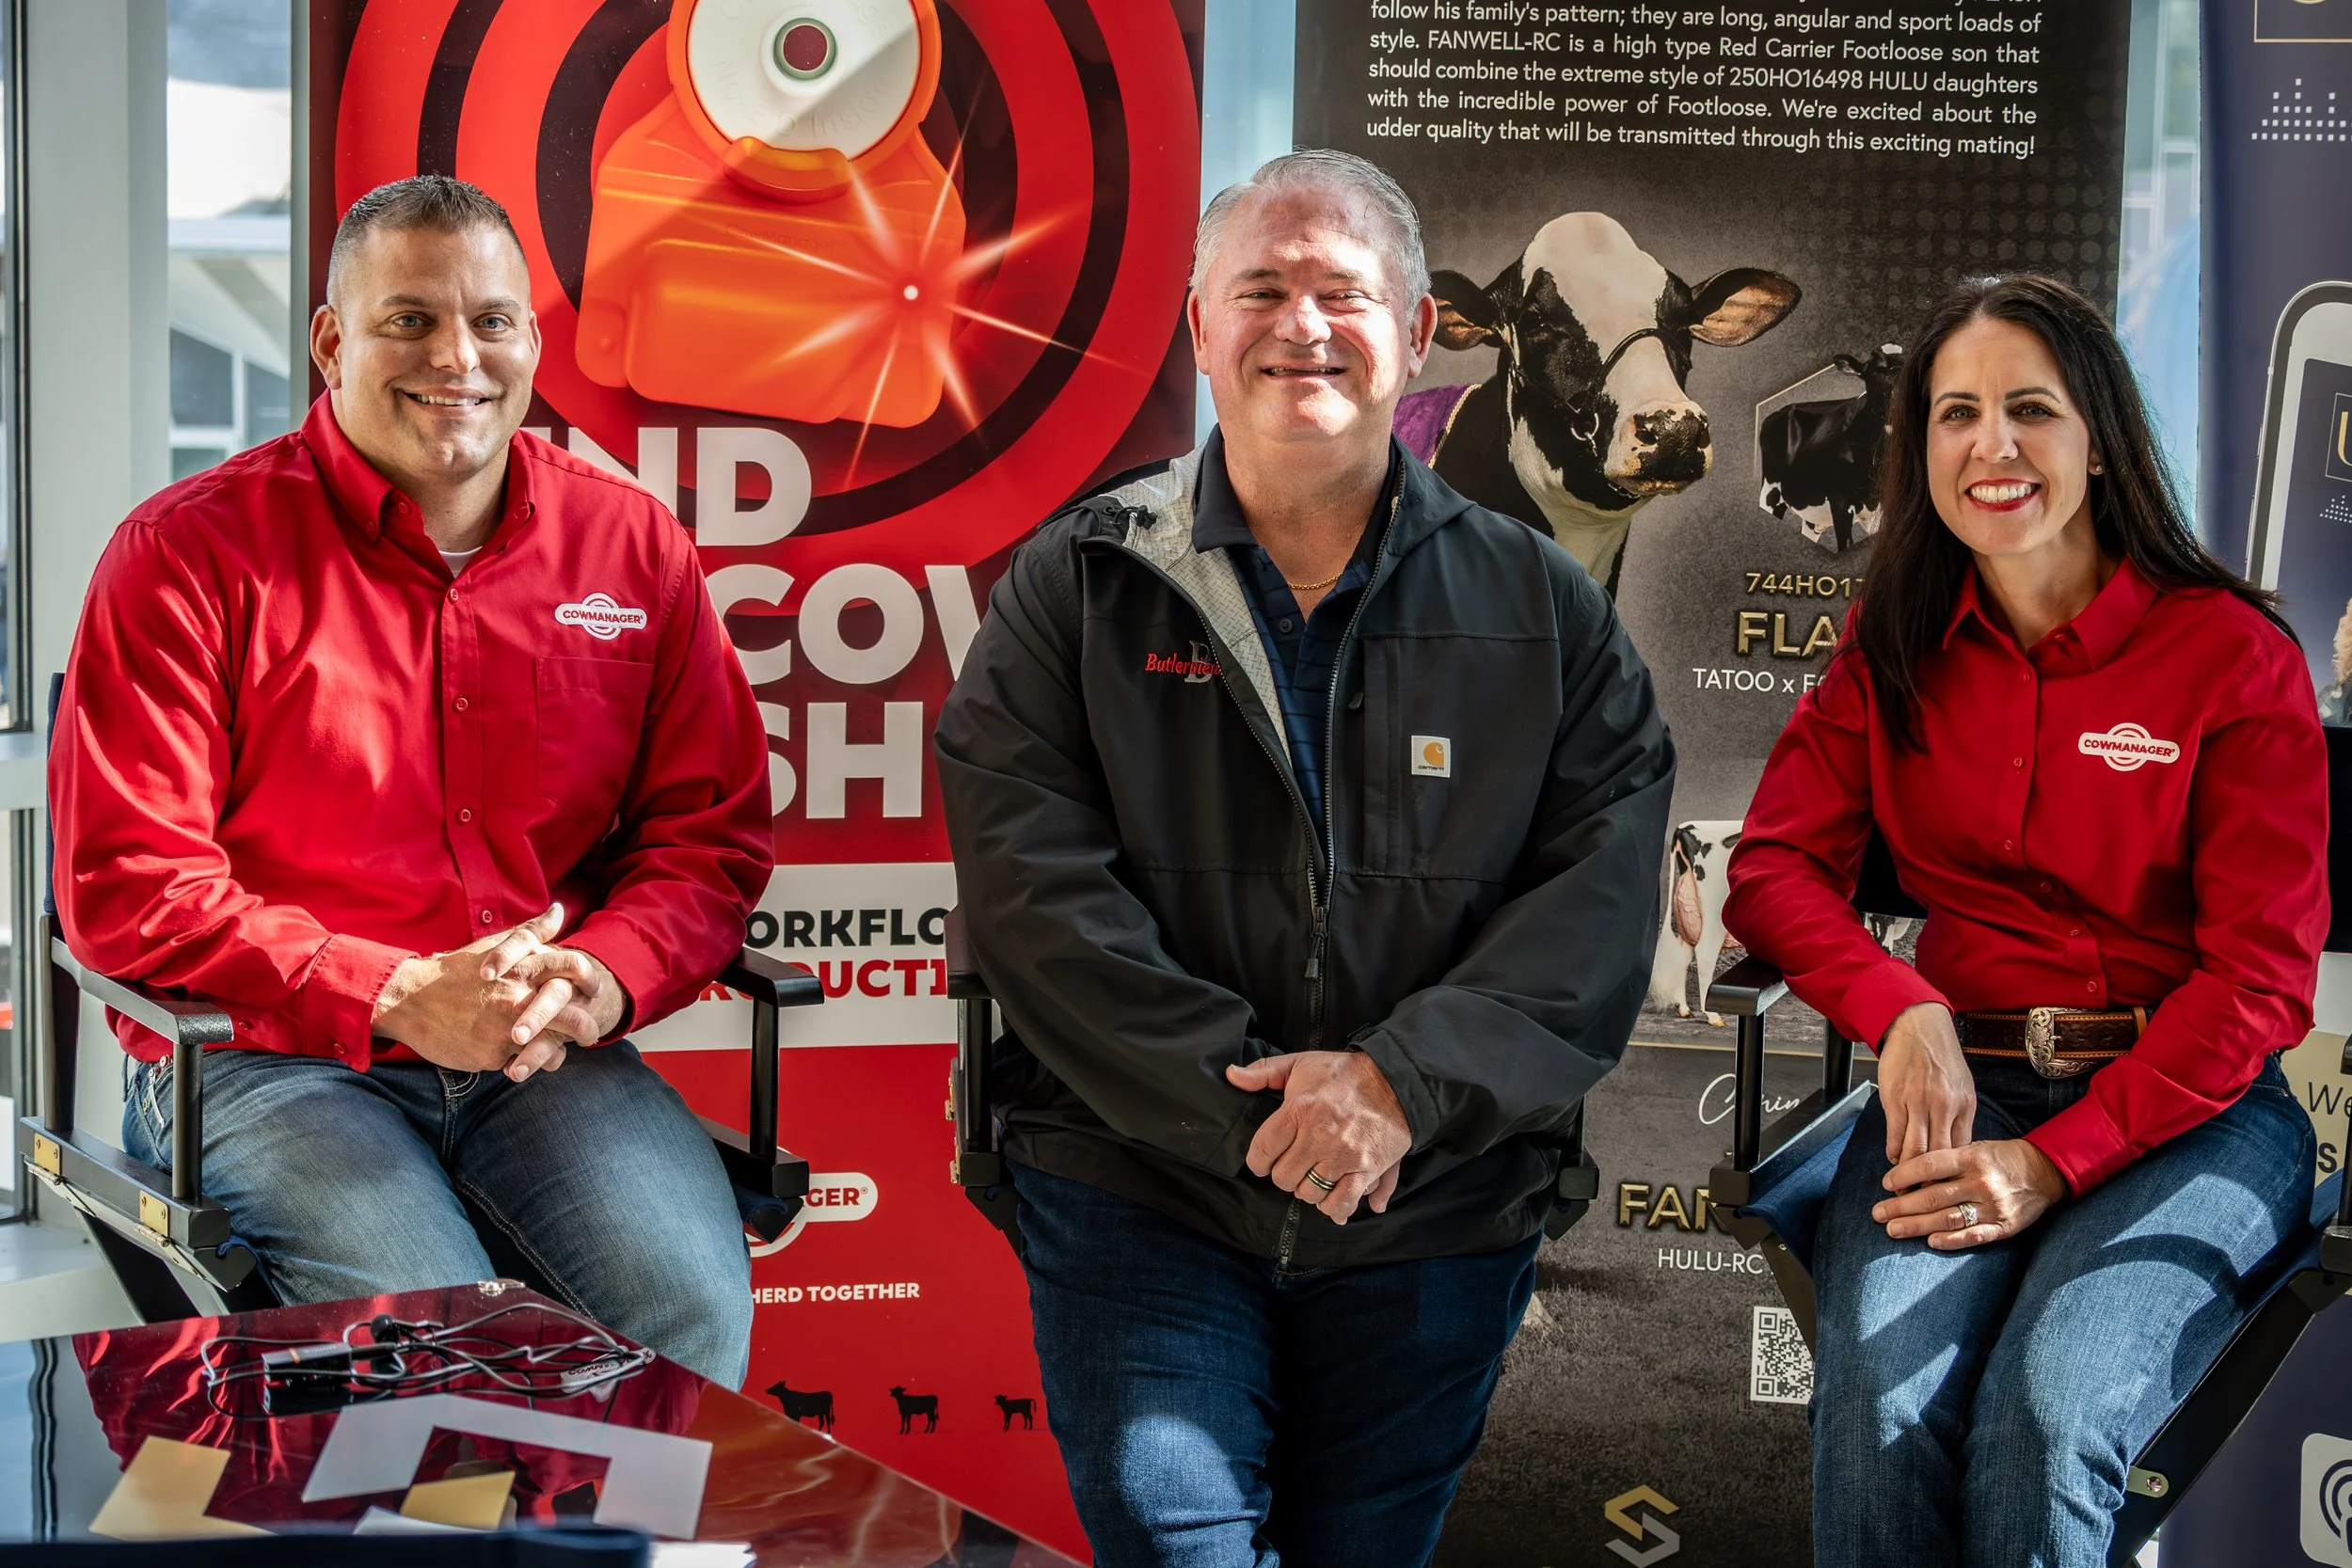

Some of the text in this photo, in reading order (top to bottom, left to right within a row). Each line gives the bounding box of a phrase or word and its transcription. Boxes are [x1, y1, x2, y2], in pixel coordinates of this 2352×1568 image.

[1370, 0, 2042, 36] follow his family's pattern; they are long, angular and sport loads of
[1369, 27, 2041, 64] style. FANWELL-RC is a high type Red Carrier Footloose son that
[1368, 56, 2039, 99] should combine the extreme style of 250HO16498 HULU daughters
[1367, 87, 2037, 125] with the incredible power of Footloose. We're excited about the
[1366, 116, 2035, 160] udder quality that will be transmitted through this exciting mating!
[518, 427, 812, 546] ND
[1745, 572, 1866, 598] 744HO1
[563, 610, 641, 625] COWMANAGER
[1692, 668, 1774, 692] TATOO
[2084, 738, 2171, 757] COWMANAGER
[1658, 1247, 1764, 1275] HULU-RC
[752, 1281, 920, 1305] HERD TOGETHER
